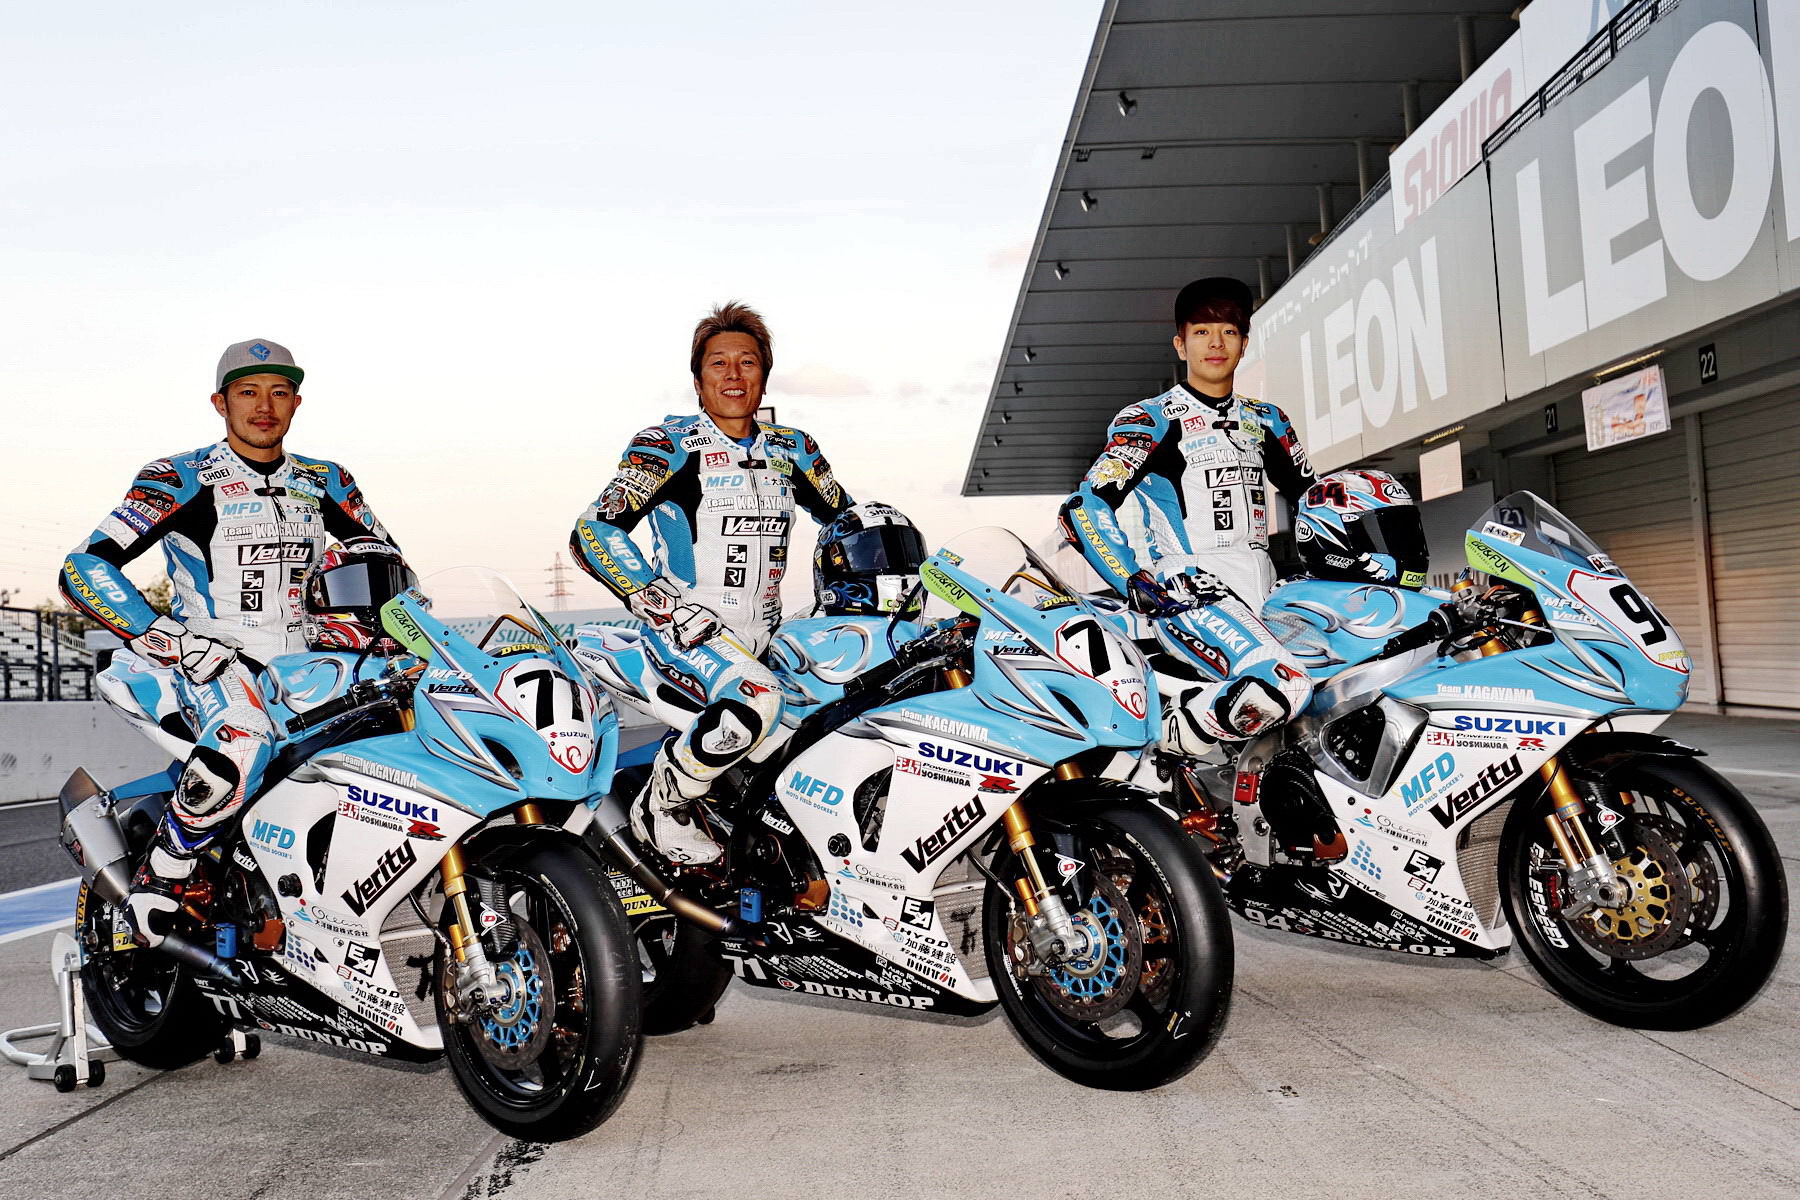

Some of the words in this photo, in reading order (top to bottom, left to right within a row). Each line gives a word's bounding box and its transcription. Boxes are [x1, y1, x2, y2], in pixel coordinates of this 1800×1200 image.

[1300, 237, 1447, 458] LEON
[1700, 351, 1716, 378] 22
[1165, 405, 1186, 416] Arai
[1546, 408, 1557, 430] 21
[685, 436, 712, 449] SHOEI
[1184, 436, 1217, 453] MFD
[201, 468, 231, 482] SHOEI
[705, 474, 744, 487] MFD
[222, 502, 263, 515] MFD
[706, 498, 734, 508] Team
[1253, 509, 1264, 519] RK
[222, 526, 252, 537] Team
[255, 522, 320, 538] KAGAYAMA
[723, 517, 787, 535] Verity
[1097, 509, 1125, 545] MFD
[1501, 509, 1523, 525] 21
[241, 543, 311, 564] Verity
[607, 535, 642, 571] MFD
[1074, 509, 1130, 579] DUNLOP
[1471, 540, 1510, 572] GO&FUN
[88, 563, 128, 602] MFD
[769, 569, 782, 578] RK
[928, 568, 965, 600] GO&FUN
[64, 560, 130, 629] DUNLOP
[1544, 597, 1585, 609] MFD
[391, 608, 421, 641] GO&FUN
[1608, 584, 1670, 646] 9
[985, 629, 1027, 642] MFD
[1061, 620, 1136, 677] 7
[1437, 684, 1462, 696] Team
[1464, 685, 1535, 702] KAGAYAMA
[901, 708, 922, 722] Team
[924, 714, 988, 742] KAGAYAMA
[1455, 715, 1566, 736] SUZUKI
[1456, 740, 1509, 750] YOSHIMURA
[918, 742, 1023, 776] SUZUKI
[922, 762, 965, 775] POWERED
[363, 759, 418, 789] KAGAYAMA
[921, 769, 971, 787] YOSHIMURA
[1400, 752, 1456, 809] MFD
[789, 771, 844, 806] MFD
[1408, 804, 1423, 818] MOTO
[1438, 773, 1464, 794] DOCKER'S
[1428, 753, 1524, 829] Verity
[348, 785, 438, 822] SUZUKI
[360, 814, 403, 833] YOSHIMURA
[761, 810, 794, 835] Verity
[1673, 787, 1732, 852] DUNLOP
[251, 819, 295, 849] MFD
[900, 794, 987, 873] Verity
[233, 847, 257, 871] Verity
[340, 839, 417, 917] Verity
[1333, 868, 1387, 900] ACTIVE
[624, 900, 657, 911] DUNL
[1426, 887, 1473, 909] HYOD
[1427, 898, 1474, 921] 加藤建設
[1244, 908, 1291, 932] 94
[1374, 921, 1404, 942] RK
[1393, 921, 1426, 941] NGK
[1427, 914, 1479, 941] DOUTOR
[900, 927, 949, 948] HYOD
[1321, 929, 1456, 957] DUNLOP
[905, 938, 957, 965] 加藤建設
[721, 954, 767, 980] 71
[882, 968, 912, 987] NGK
[906, 958, 957, 988] DOUTOR
[352, 976, 400, 998] HYOD
[802, 980, 934, 1010] DUNLOP
[355, 987, 405, 1016] 加藤建設
[357, 1005, 402, 1036] DOUTOR
[276, 1023, 388, 1056] DUNLOP
